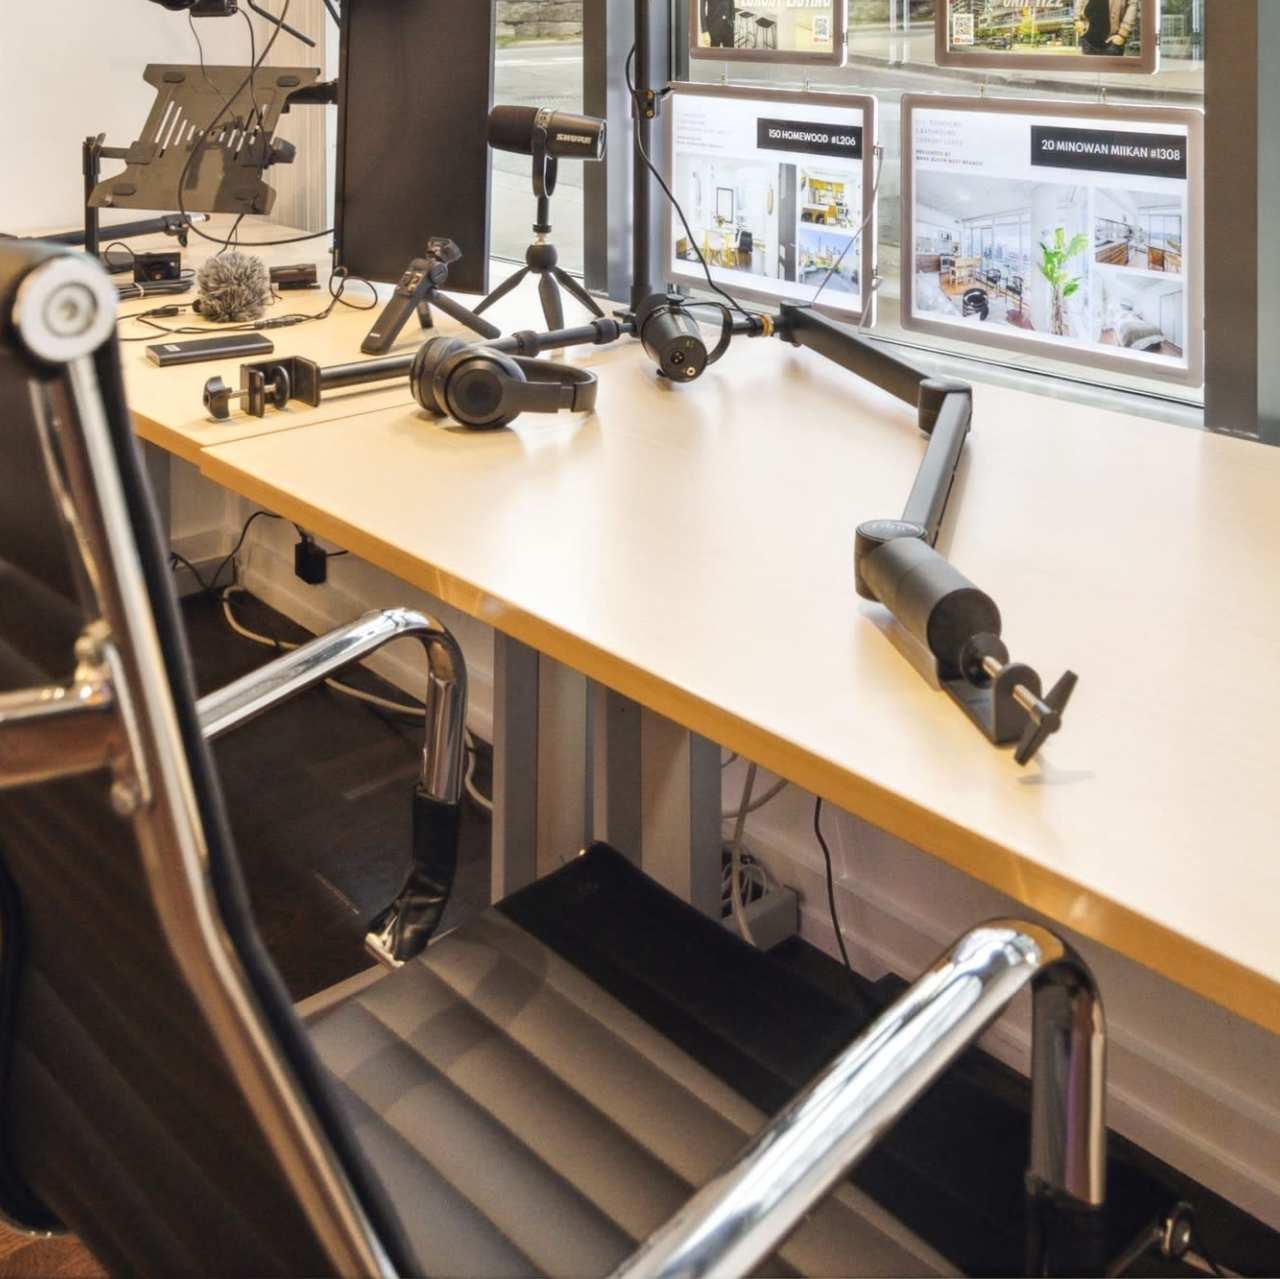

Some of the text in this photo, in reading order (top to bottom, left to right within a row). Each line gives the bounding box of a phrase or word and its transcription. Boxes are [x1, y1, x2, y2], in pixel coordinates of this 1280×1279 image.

[782, 130, 829, 143] HOMEWOOD
[1041, 140, 1181, 160] 20 MINOWAN MIIKAN #1308
